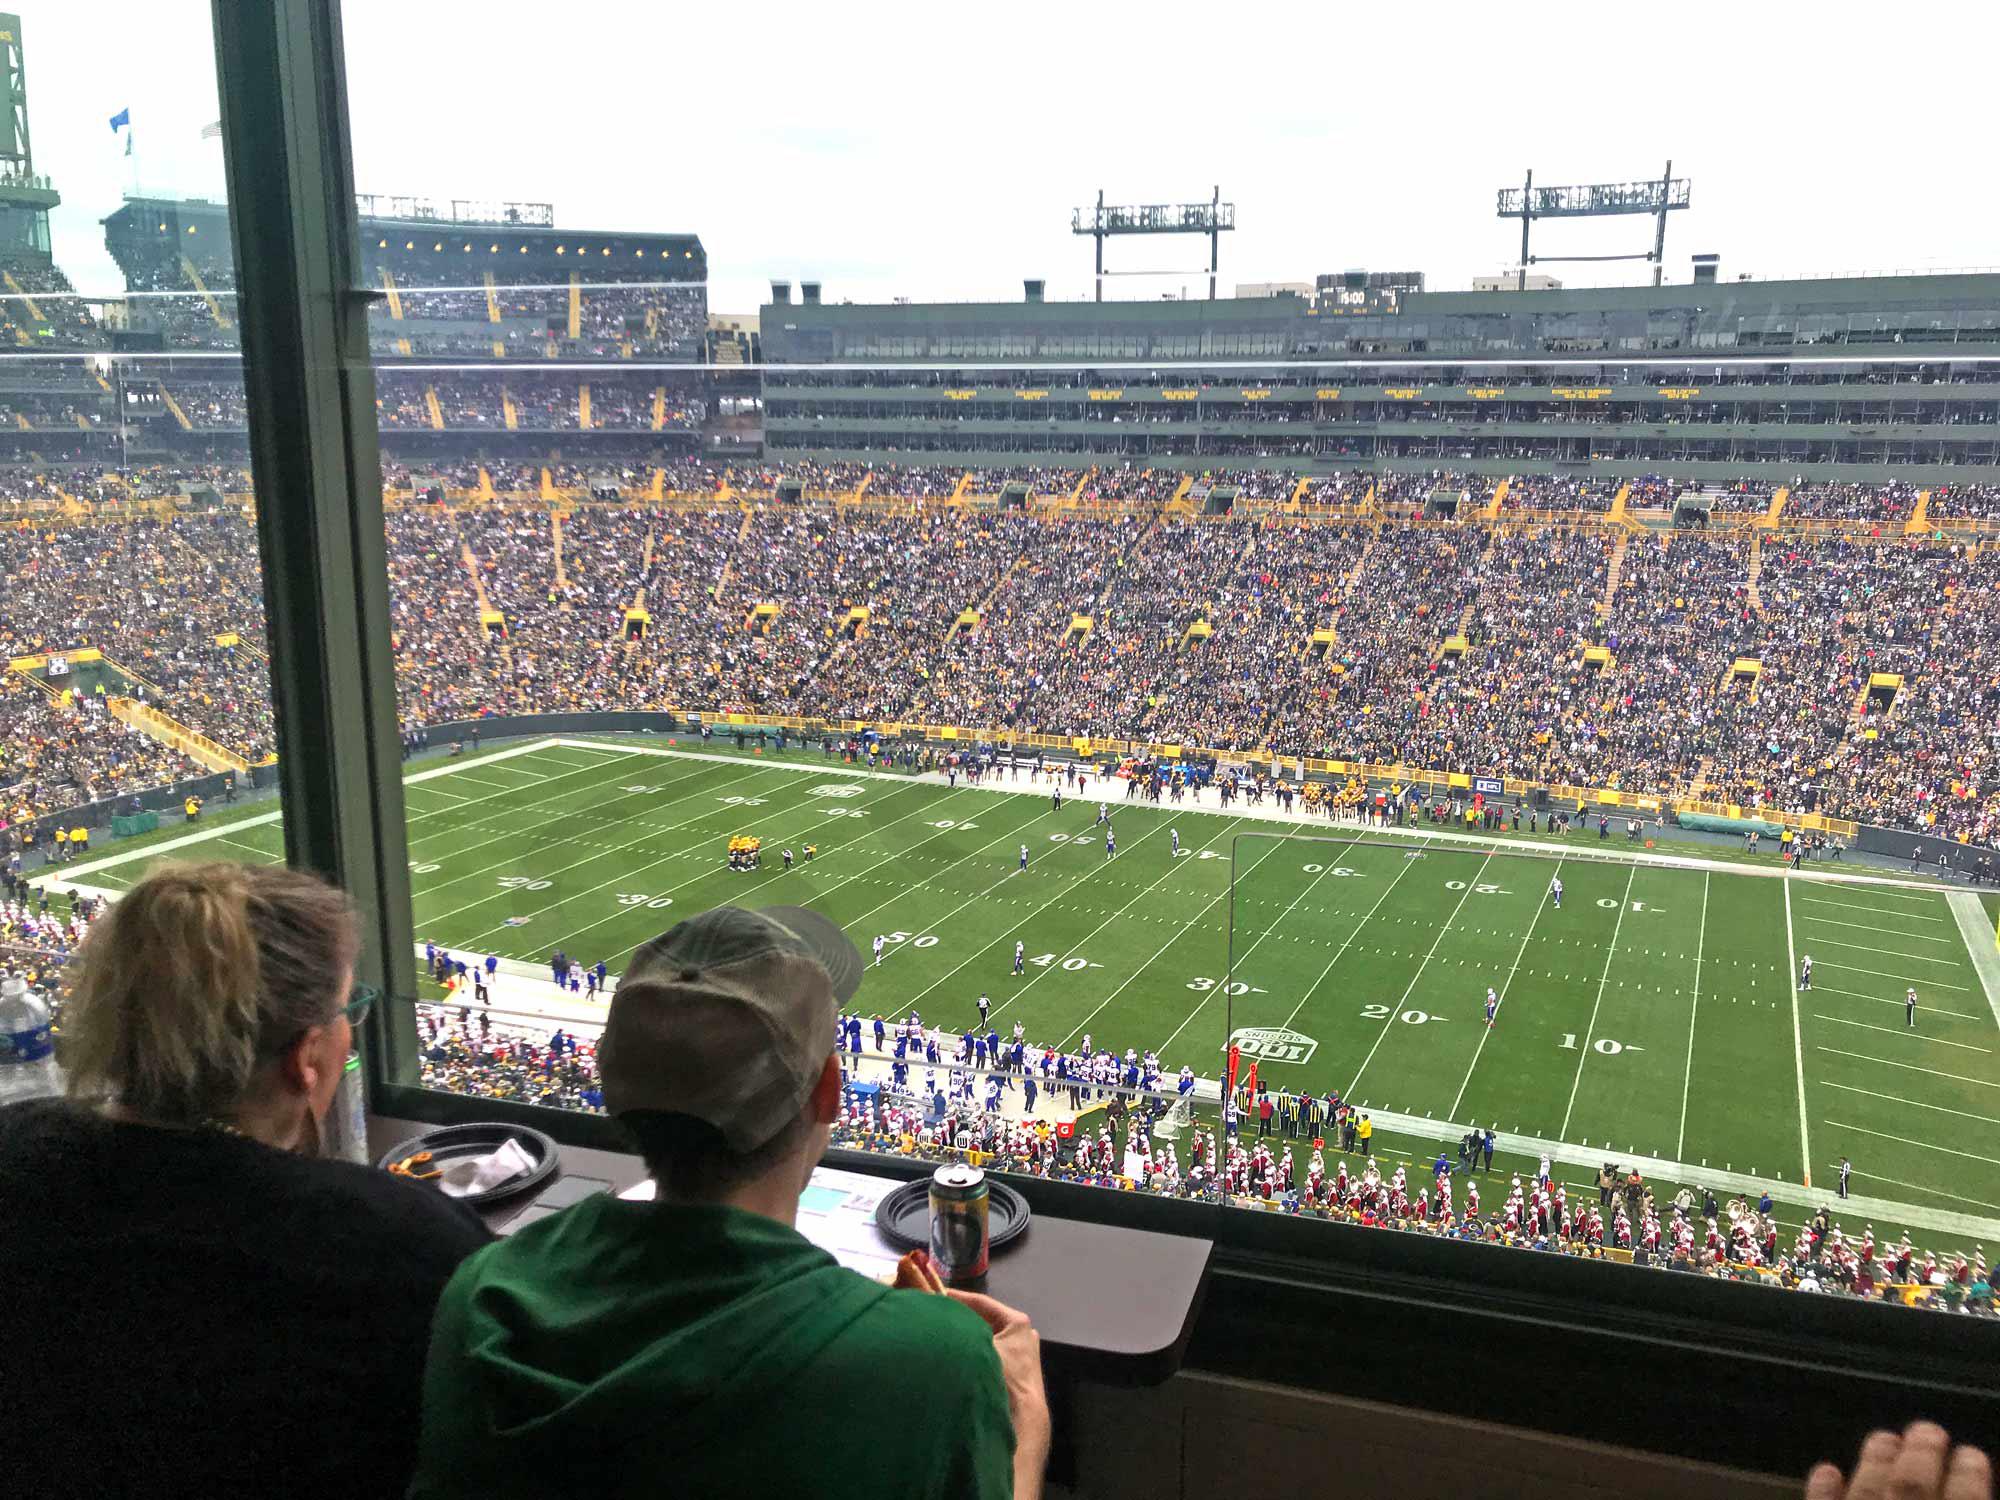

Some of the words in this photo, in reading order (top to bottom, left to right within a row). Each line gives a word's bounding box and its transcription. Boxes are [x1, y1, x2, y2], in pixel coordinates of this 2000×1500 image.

[1341, 291, 1365, 304] 15:00
[883, 931, 939, 948] 50
[1029, 953, 1087, 970] 40
[1186, 977, 1249, 995] 30
[1359, 1004, 1428, 1025] 20
[1558, 1033, 1622, 1055] 10
[1061, 1126, 1069, 1135] G
